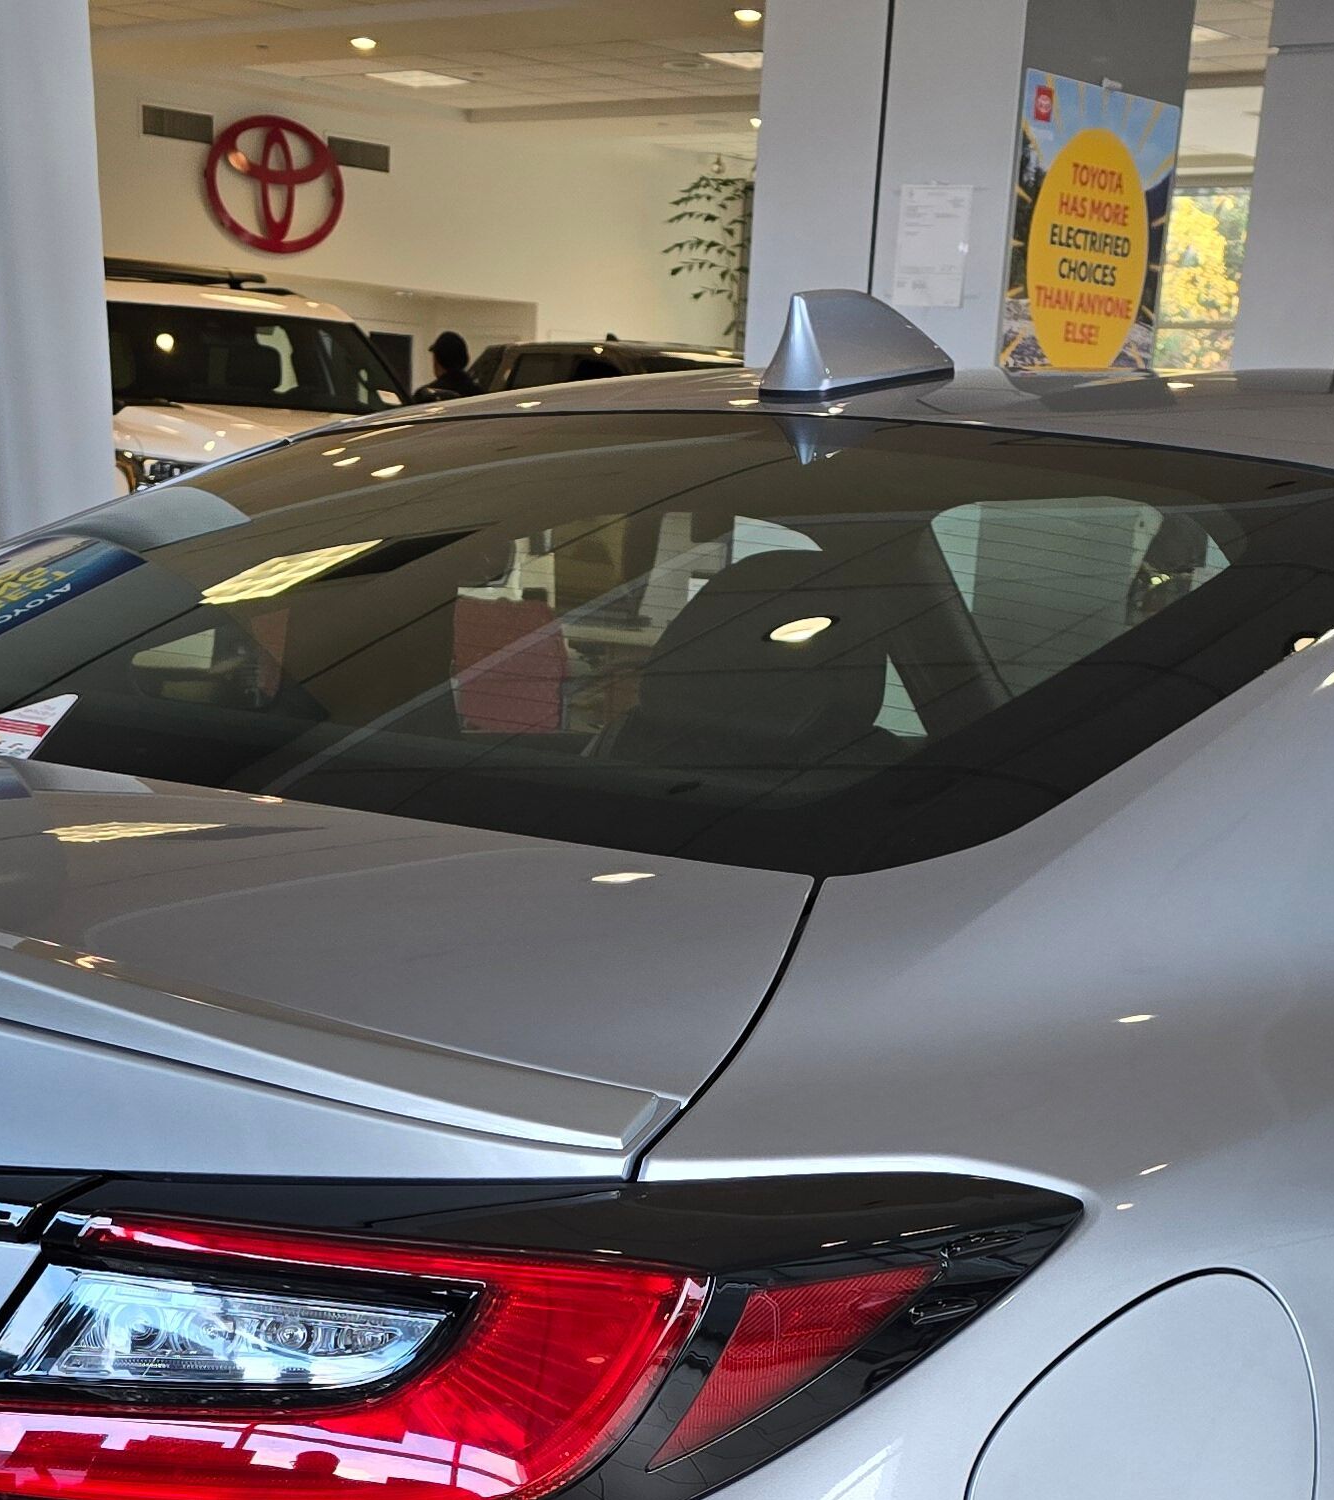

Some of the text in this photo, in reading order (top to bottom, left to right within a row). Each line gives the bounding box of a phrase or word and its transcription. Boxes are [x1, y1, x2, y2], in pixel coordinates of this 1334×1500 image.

[1072, 162, 1123, 194] TOYOTA
[1058, 192, 1129, 227] HAS MORE
[1049, 223, 1131, 258] ELECTRIFIED
[1058, 257, 1117, 287] CHOICES
[1035, 285, 1132, 320] THAN ANYONE
